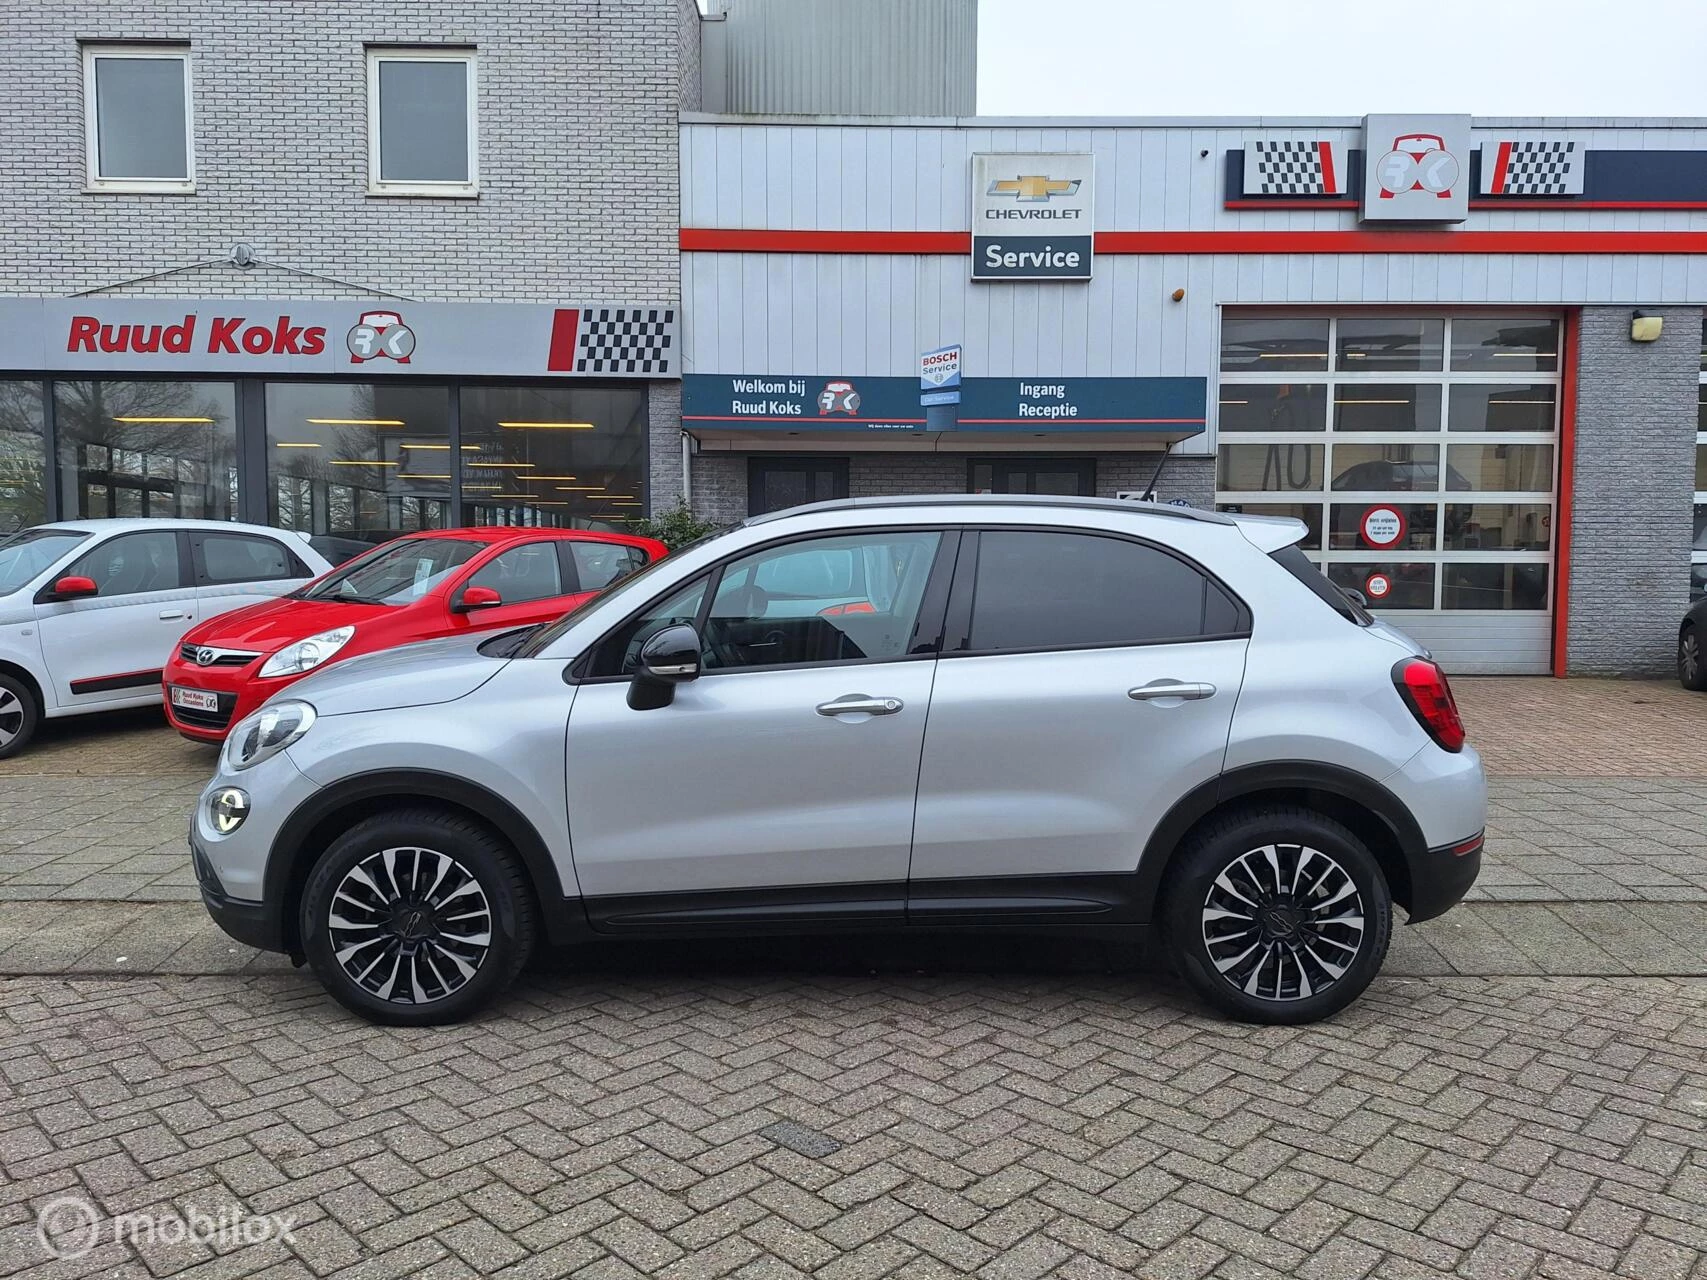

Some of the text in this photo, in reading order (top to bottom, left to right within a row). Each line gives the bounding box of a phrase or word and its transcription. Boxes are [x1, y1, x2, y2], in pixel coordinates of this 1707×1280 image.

[985, 209, 1082, 219] CHEVROLET
[985, 244, 1080, 267] Service
[67, 315, 326, 355] Ruud Koks
[923, 351, 957, 366] BOSCH
[922, 362, 957, 375] Service
[732, 379, 806, 397] Welkom bij
[1020, 382, 1065, 399] Ingang
[732, 400, 802, 415] Ruud Koks
[1019, 402, 1078, 419] Receptie
